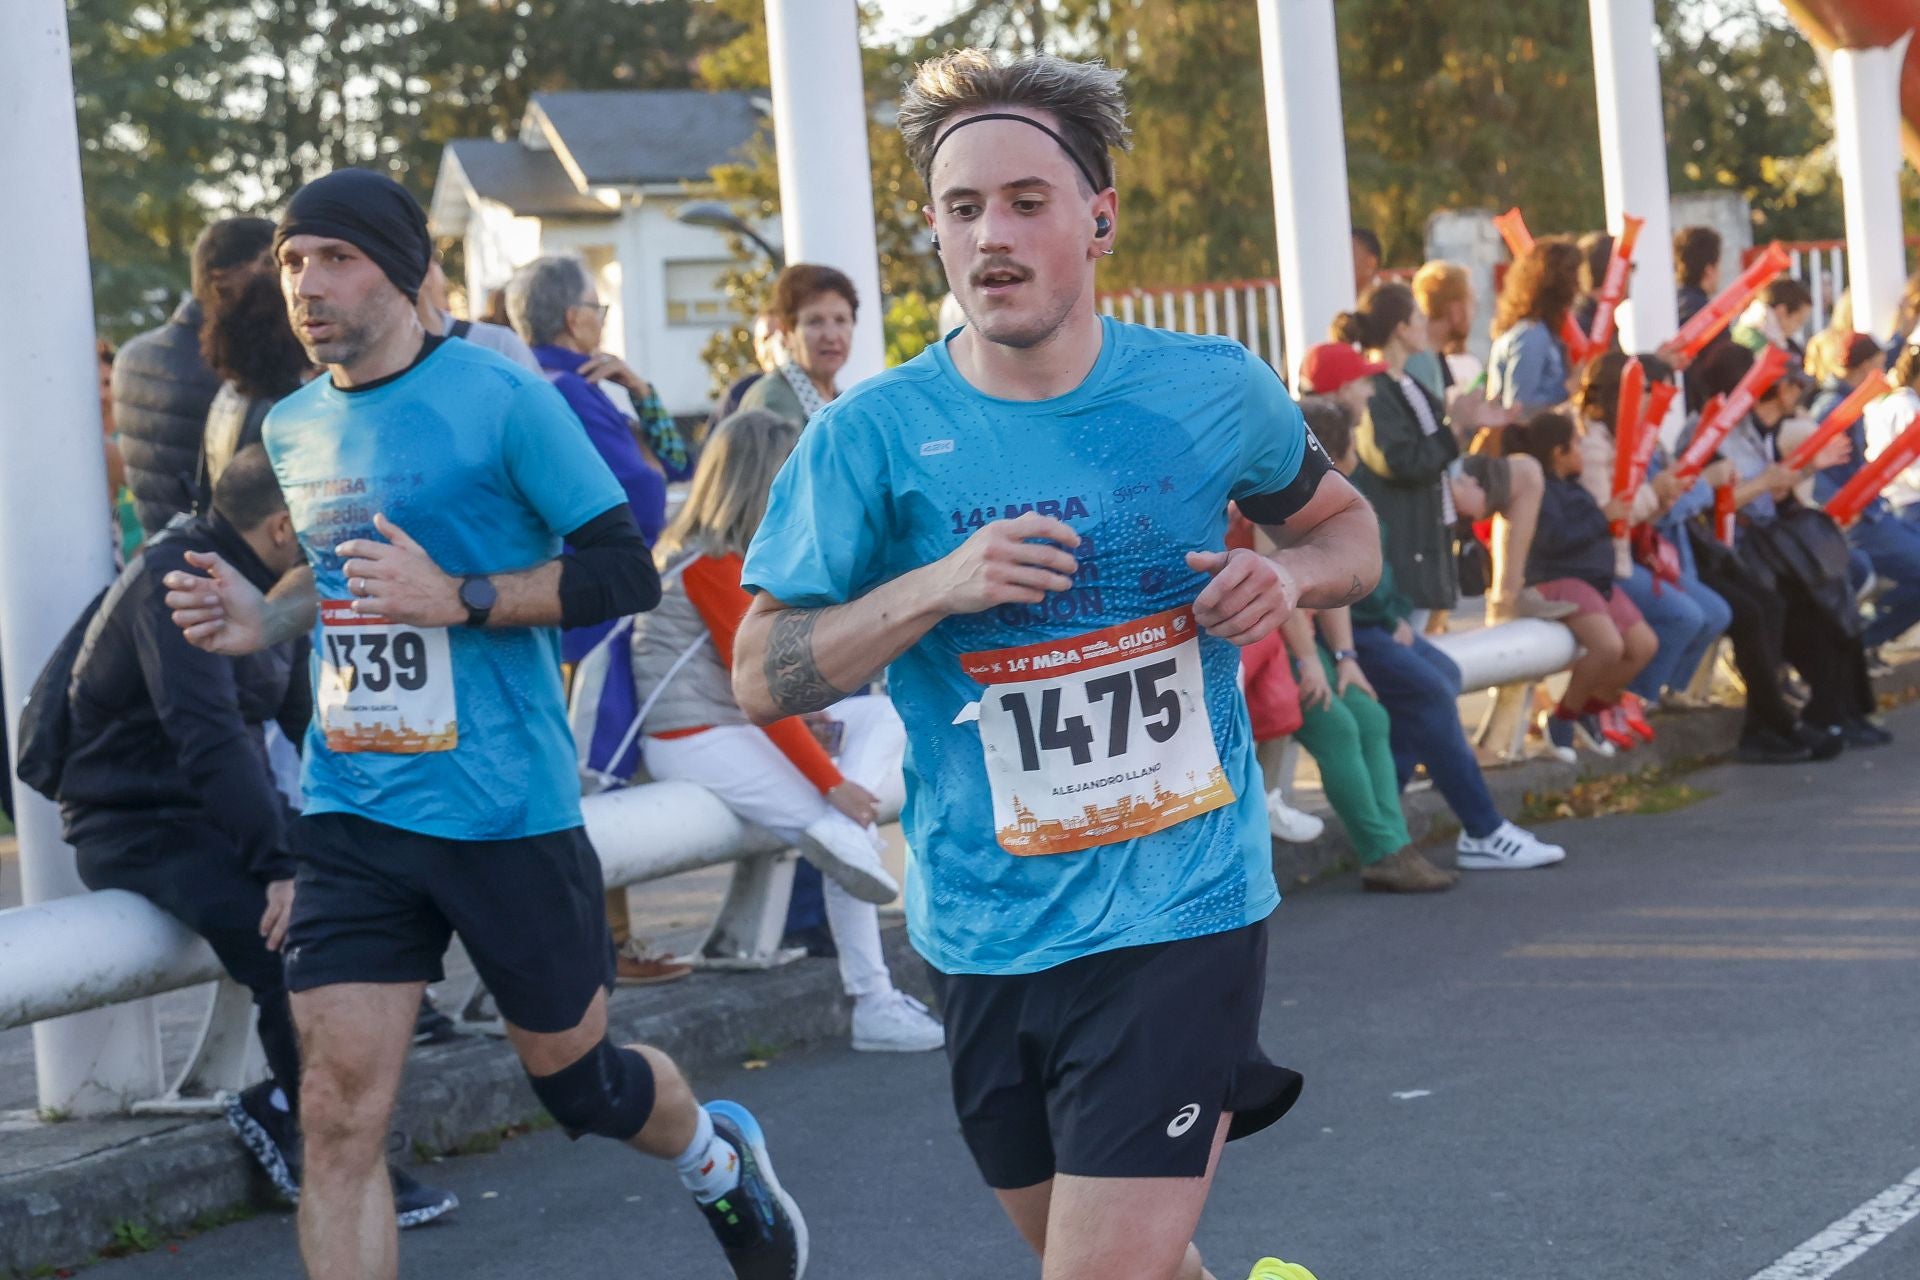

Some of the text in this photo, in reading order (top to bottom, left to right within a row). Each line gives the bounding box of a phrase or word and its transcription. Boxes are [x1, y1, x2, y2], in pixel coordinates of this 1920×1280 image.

[1004, 496, 1090, 521] MBA
[1118, 626, 1167, 651] GIJÓN
[1032, 649, 1082, 670] MBA
[1000, 657, 1182, 772] 1475
[1052, 774, 1125, 796] ALEJANDRO
